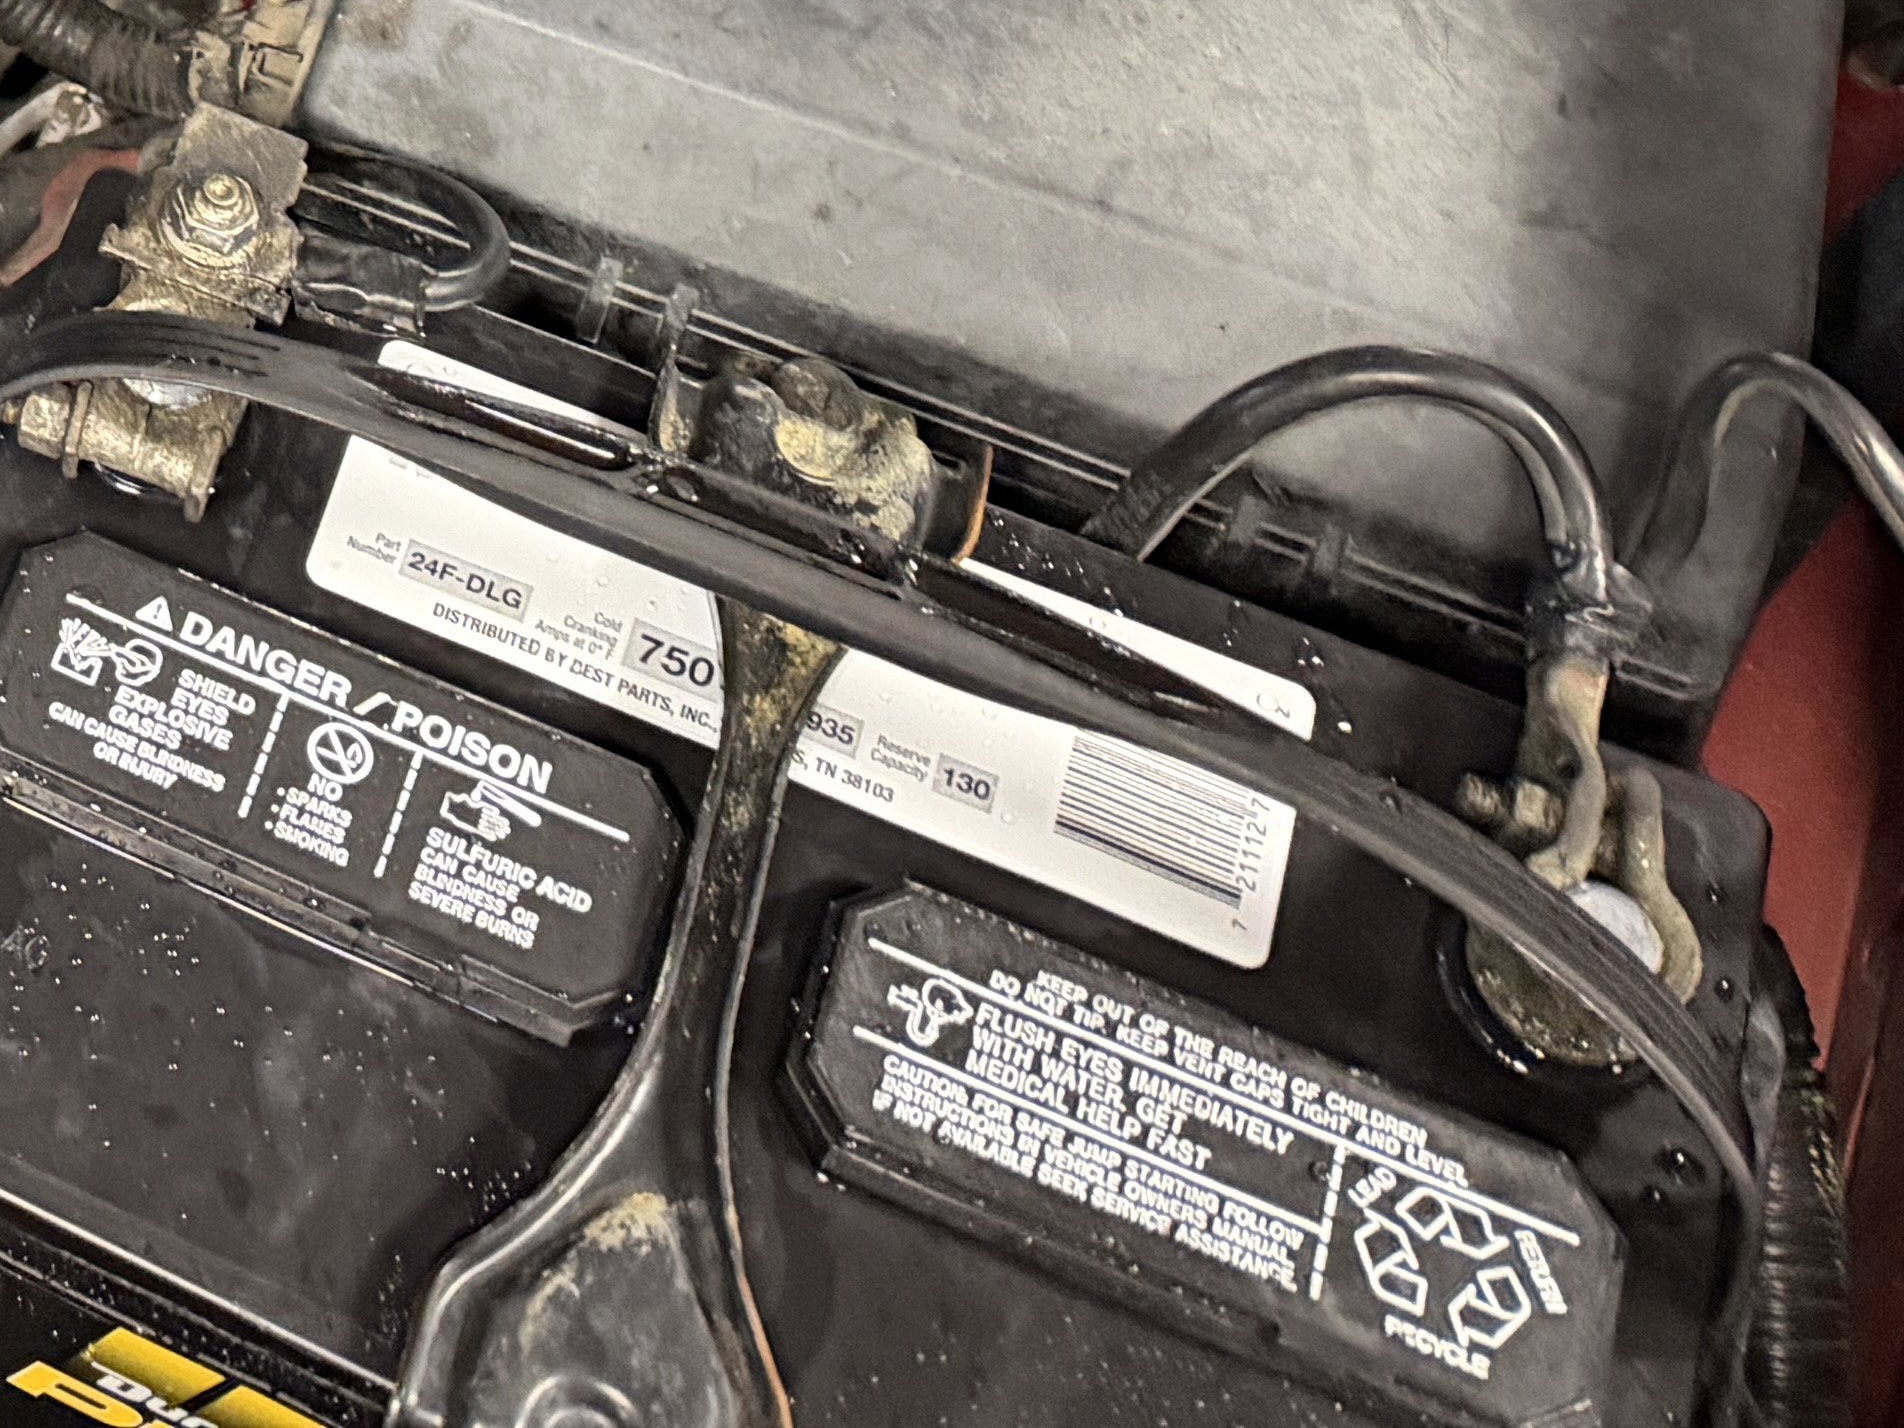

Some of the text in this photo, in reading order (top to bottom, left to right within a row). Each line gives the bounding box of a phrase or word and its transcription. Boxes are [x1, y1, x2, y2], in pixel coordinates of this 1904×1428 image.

[347, 534, 398, 565] Number
[375, 532, 402, 553] Part
[407, 551, 524, 611] 24F-DLG
[535, 619, 571, 647] Amps
[563, 614, 618, 647] Cranking
[594, 611, 623, 633] Cold
[432, 601, 541, 657] DISTRIBUTED
[545, 648, 567, 672] BY
[617, 678, 676, 718] PARTS,
[638, 632, 715, 688] 750
[114, 684, 234, 751] EXPLOSIVE
[171, 687, 230, 726] EYES
[178, 667, 257, 716] SHIELD
[48, 701, 226, 793] CAN CAUSE BLINDNESS
[108, 705, 183, 750] GASES
[877, 734, 932, 768] Reserve
[93, 741, 178, 790] OR INJURY
[307, 772, 343, 801] NO
[816, 756, 838, 779] TN
[841, 769, 895, 803] 38103
[870, 748, 928, 783] Capacity
[943, 767, 991, 801] 130
[413, 863, 540, 932] BLINDNESS OR
[420, 847, 522, 904] CAN CAUSE
[425, 826, 593, 913] SULFURIC ACID
[408, 880, 535, 950] SEVERE BURNS
[972, 1024, 1034, 1072] WITH
[1135, 1095, 1189, 1136] GET
[975, 1002, 1295, 1155] FLUSH EYES IMMEDIATELY
[989, 969, 1021, 996] DO
[1024, 982, 1068, 1017] NOT
[1115, 1023, 1169, 1056] KEEP
[1173, 1046, 1226, 1083] VENT
[1229, 1071, 1285, 1109] CAPS
[1292, 1096, 1352, 1135] TIGHT
[1355, 1124, 1401, 1159] AND
[1035, 969, 1429, 1149] KEEP OUT OF THE REACH OF CHILDREN
[964, 1048, 1213, 1171] MEDICAL HELP FAST
[880, 1073, 1015, 1145] INSTRUCTIONS
[1017, 1134, 1041, 1158] IN
[1044, 1144, 1122, 1192] VEHICLE
[1123, 1180, 1208, 1231] OWNERS
[893, 1100, 936, 1133] NOT
[937, 1118, 1037, 1178] AVAILABLE
[1037, 1162, 1088, 1203] SEEK
[1090, 1186, 1172, 1236] SERVICE
[972, 1092, 1014, 1127] FOR
[1015, 1110, 1066, 1148] SAFE
[1067, 1135, 1122, 1170] JUMP
[1123, 1158, 1220, 1216] STARTING
[1222, 1200, 1305, 1251] FOLLOW
[1347, 1165, 1397, 1208] LEAD
[1513, 1229, 1568, 1314] RETURN
[1384, 1313, 1491, 1380] RECYCLE
